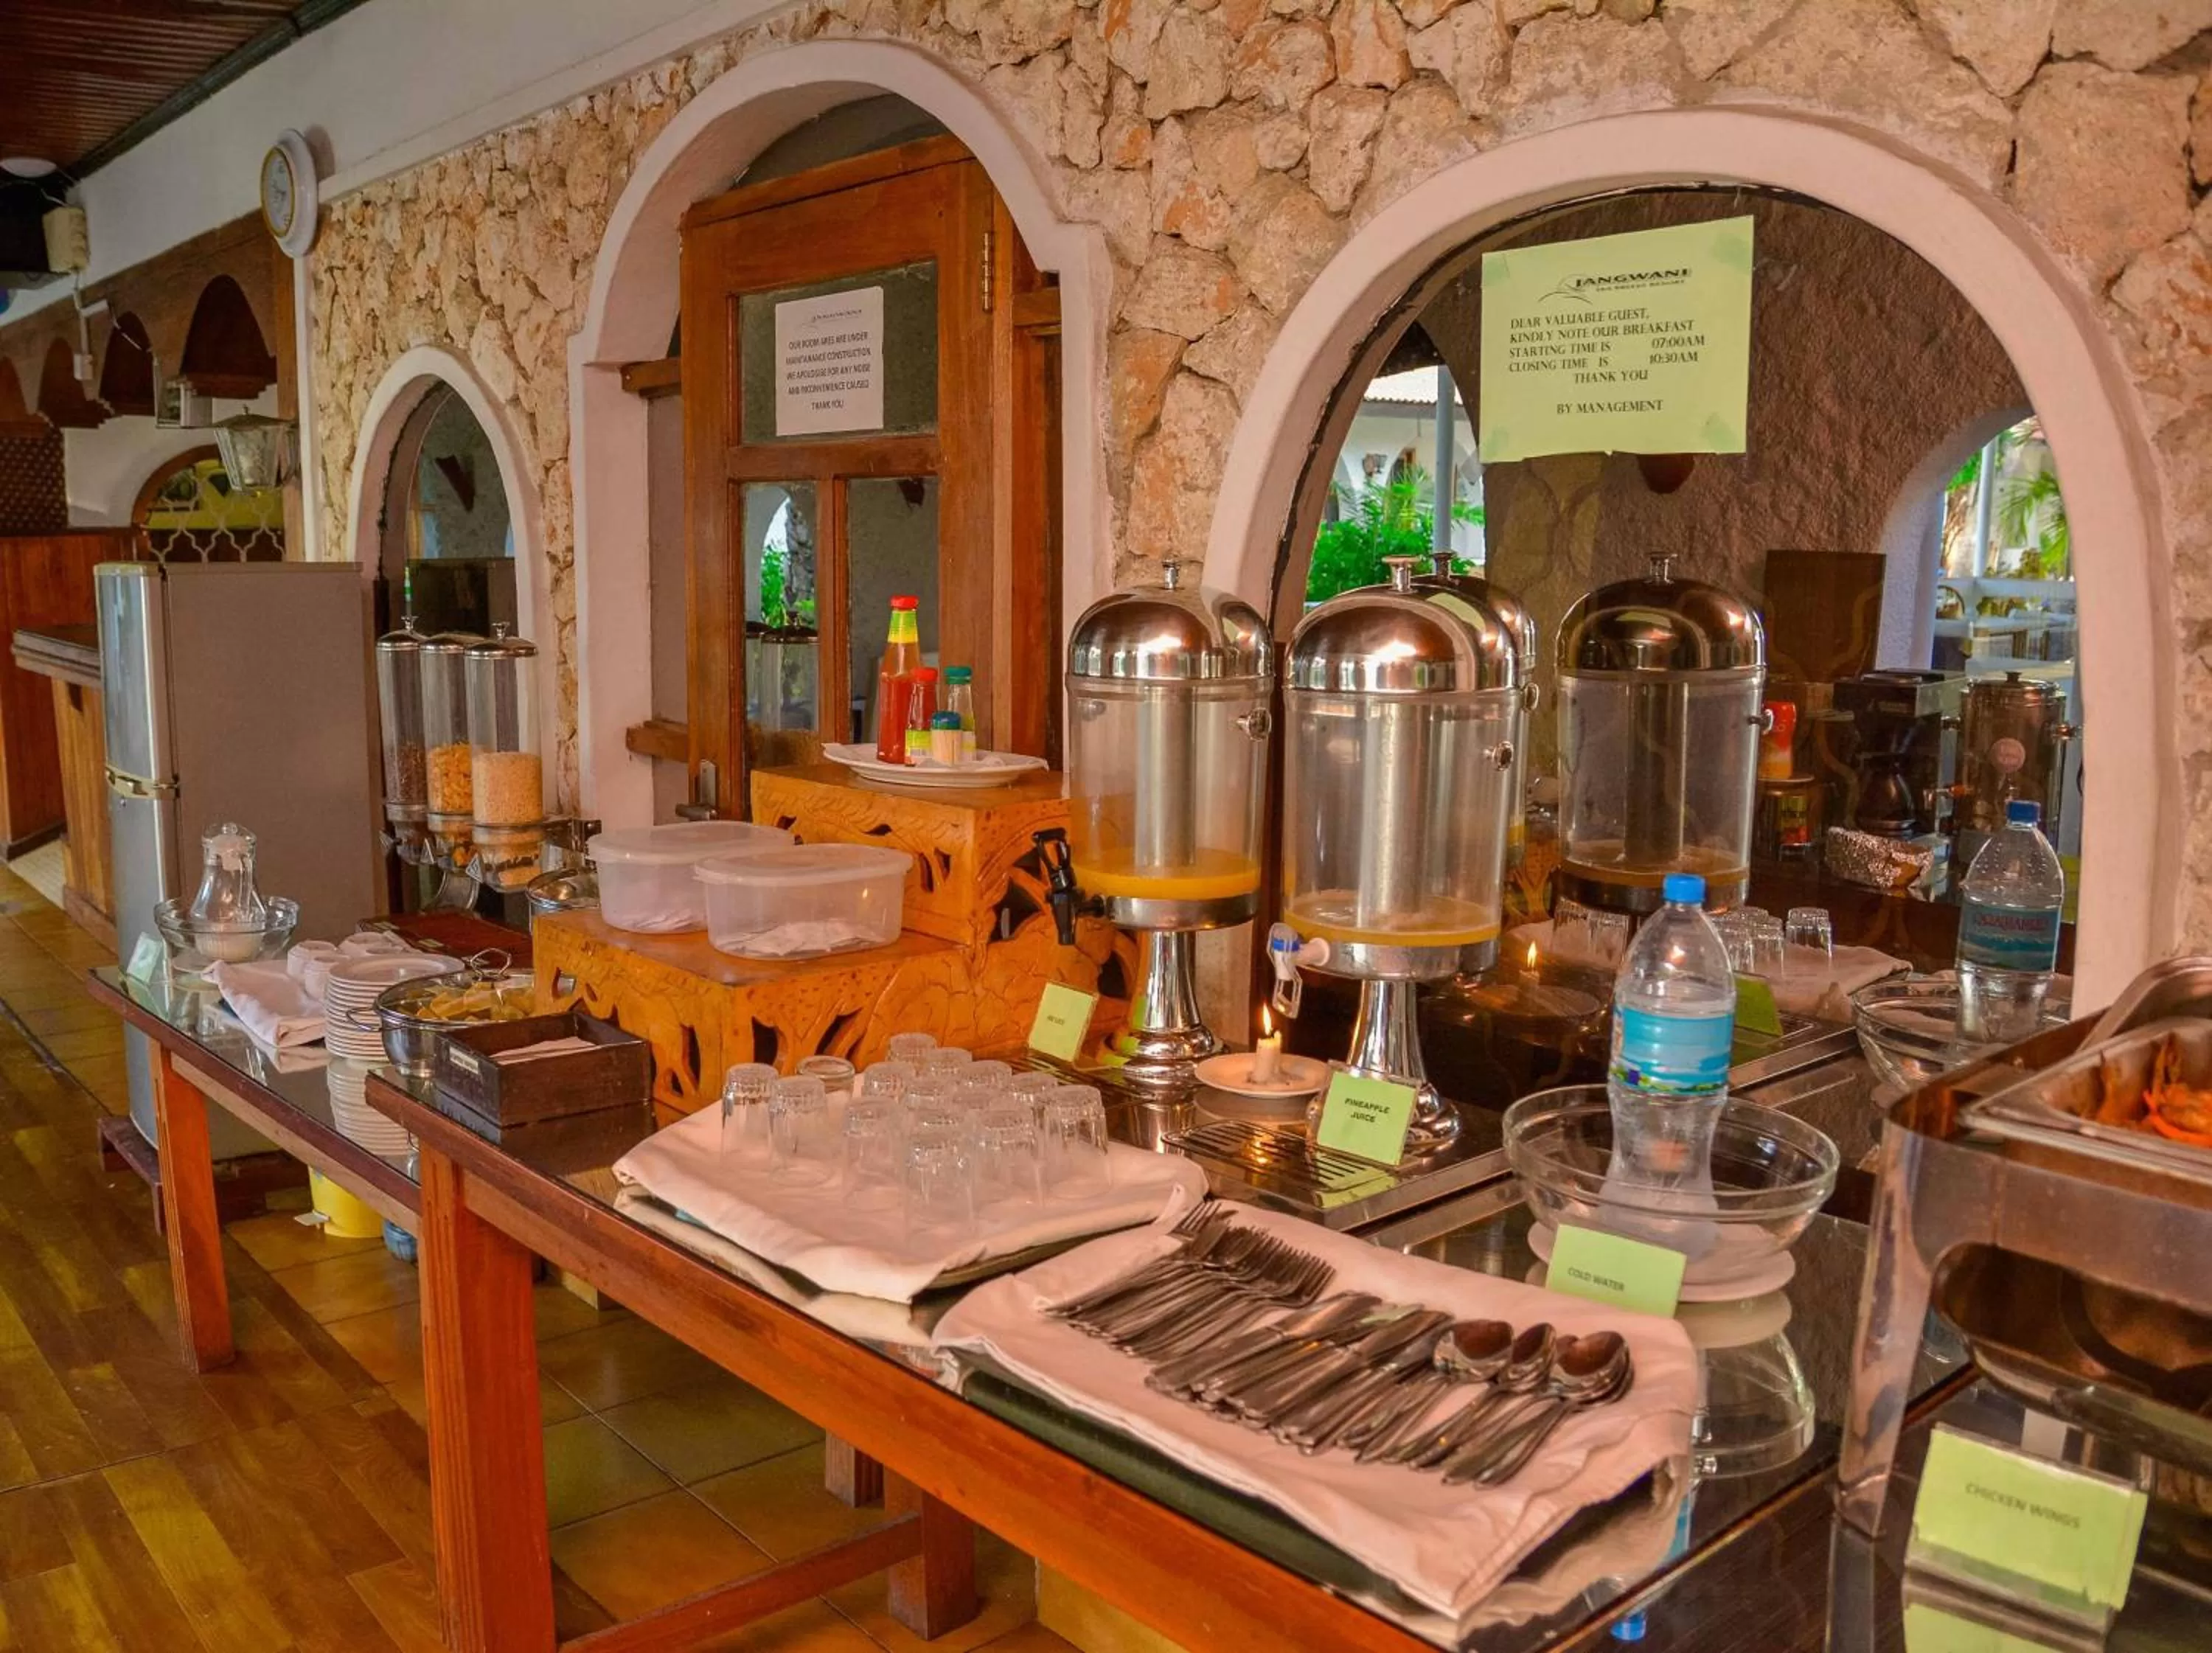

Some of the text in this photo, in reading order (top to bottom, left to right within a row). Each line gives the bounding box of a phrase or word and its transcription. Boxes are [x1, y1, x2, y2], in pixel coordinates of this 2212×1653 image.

[1511, 316, 1540, 329] DEAR
[1545, 311, 1605, 325] VALUABLE
[1510, 319, 1694, 344] KINDLY NOTE OUR BREAKFAST
[1509, 344, 1565, 358] STARTING
[1569, 341, 1597, 355] TIME
[1601, 341, 1611, 352] IS
[1509, 358, 1557, 372] CLOSING
[1559, 357, 1589, 369] TIME
[1599, 355, 1609, 368] IS
[1573, 369, 1649, 384] THANK YOU
[1557, 399, 1664, 414] BY MANAGEMENT
[1344, 1097, 1391, 1114] PINEAPPLE
[1351, 1111, 1377, 1123] JUICE
[1965, 1480, 2081, 1531] CHICKEN WINGS
